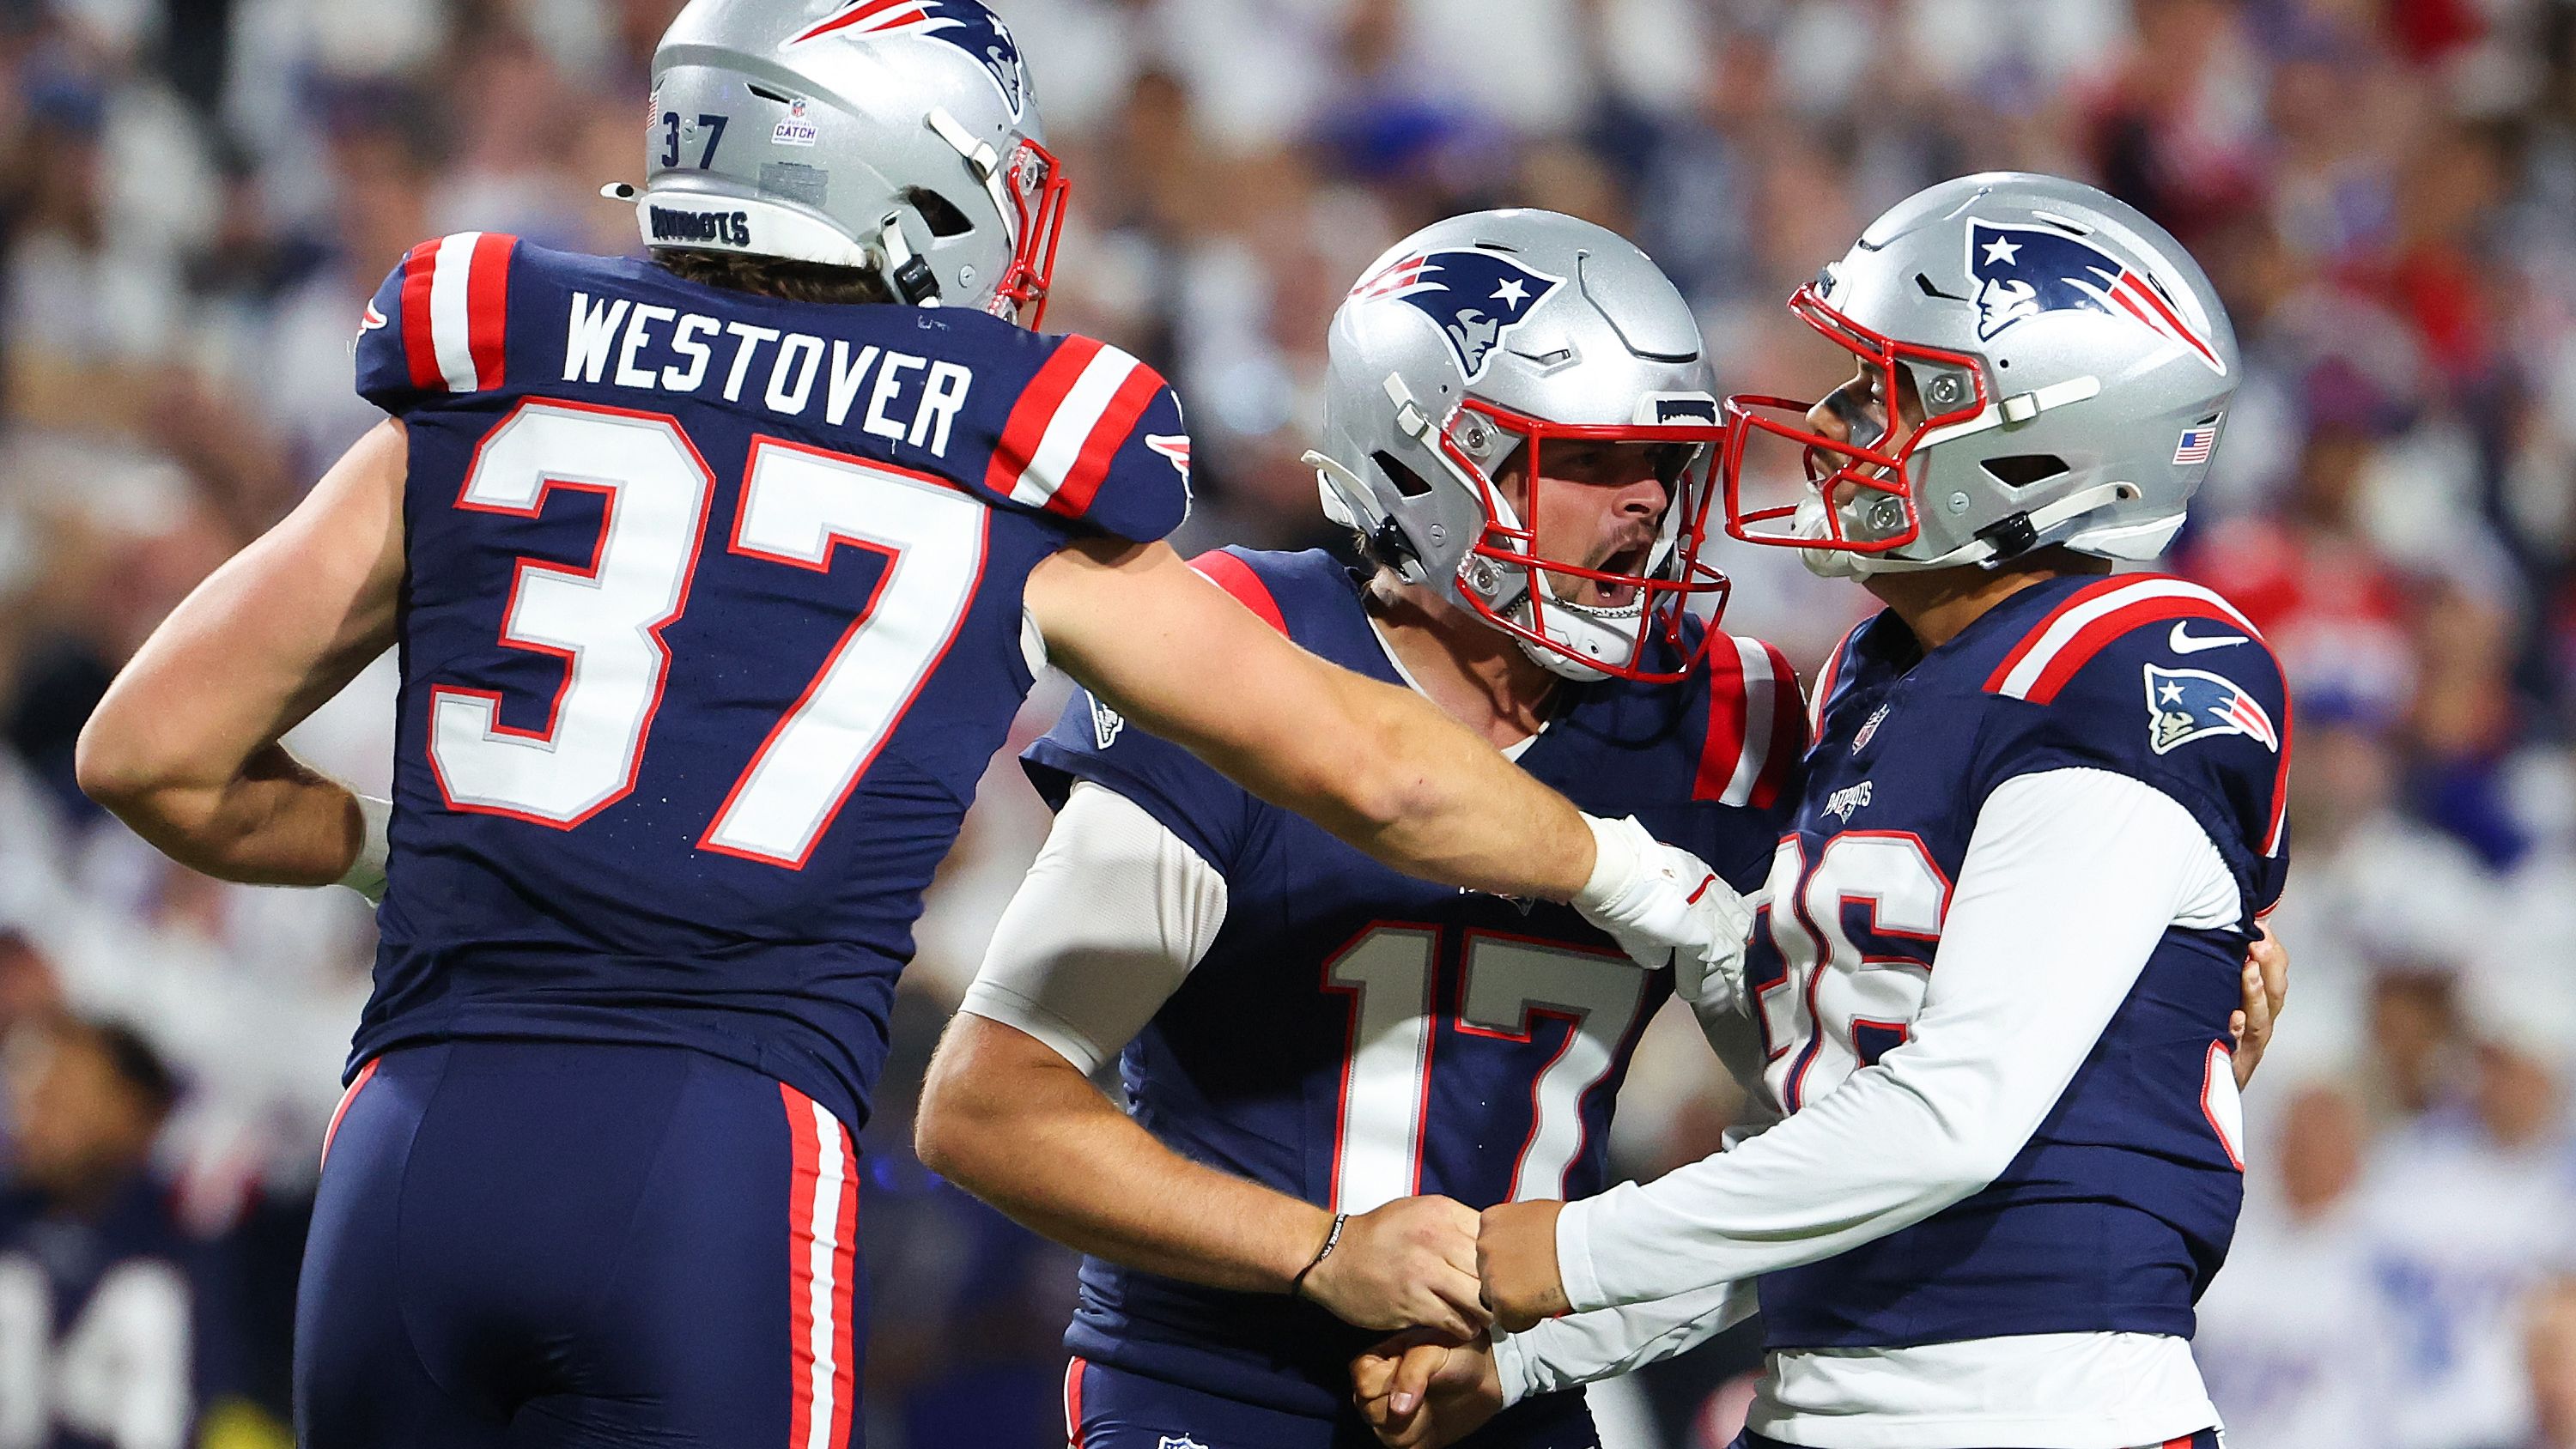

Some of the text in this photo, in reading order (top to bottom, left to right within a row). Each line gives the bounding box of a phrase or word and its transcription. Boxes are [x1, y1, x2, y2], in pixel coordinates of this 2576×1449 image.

[661, 112, 729, 170] 37
[775, 125, 817, 139] CATCH
[562, 291, 973, 458] WESTOVER
[426, 394, 991, 871] 37
[1320, 919, 1655, 1214] 17
